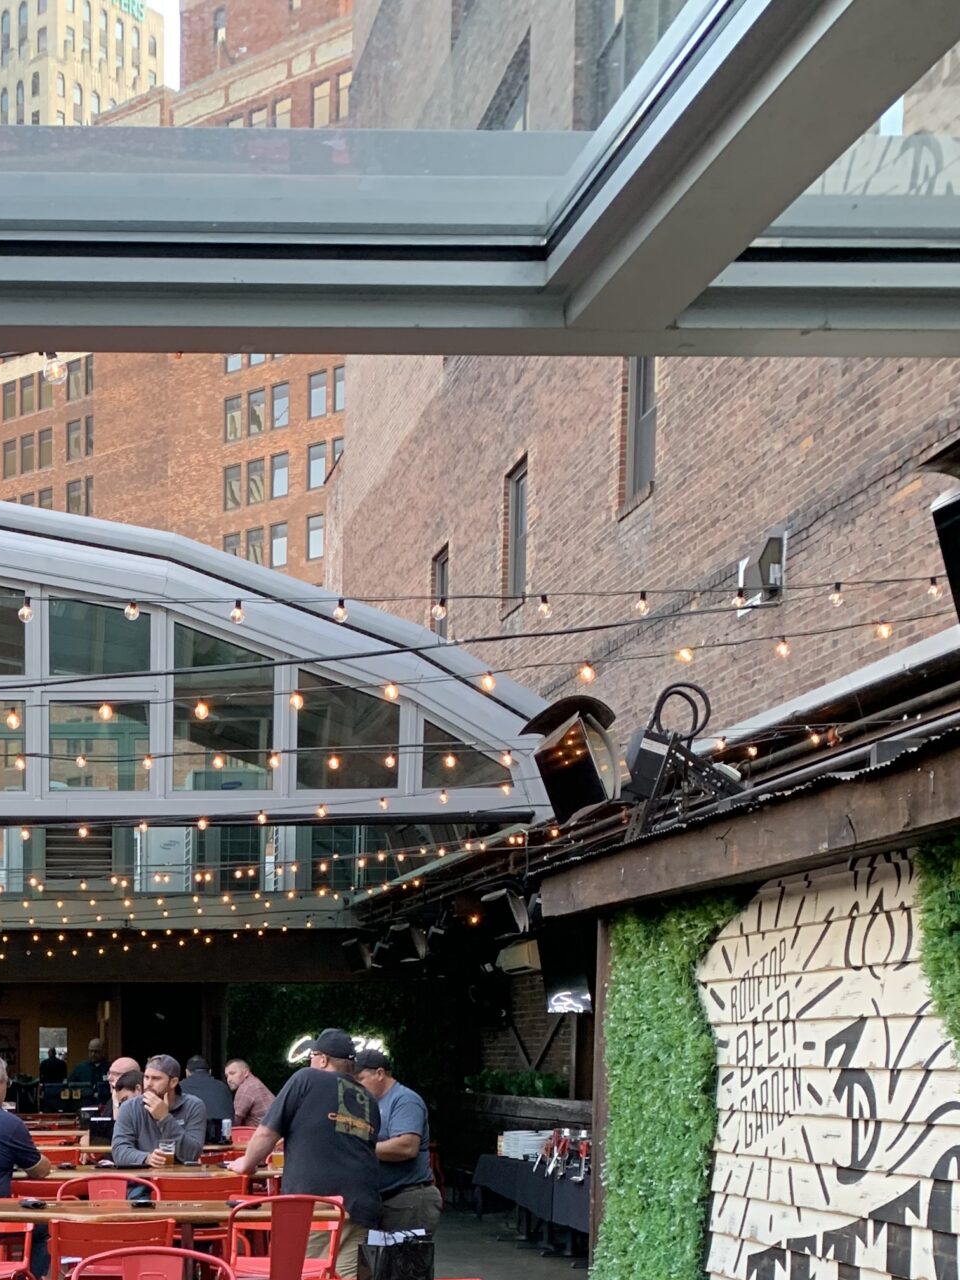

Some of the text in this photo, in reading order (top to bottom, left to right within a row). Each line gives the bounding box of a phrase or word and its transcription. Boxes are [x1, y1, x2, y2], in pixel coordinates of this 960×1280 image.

[731, 936, 788, 1026] ROOFTOP
[736, 990, 797, 1089] BEER
[739, 1056, 802, 1150] GARDEN
